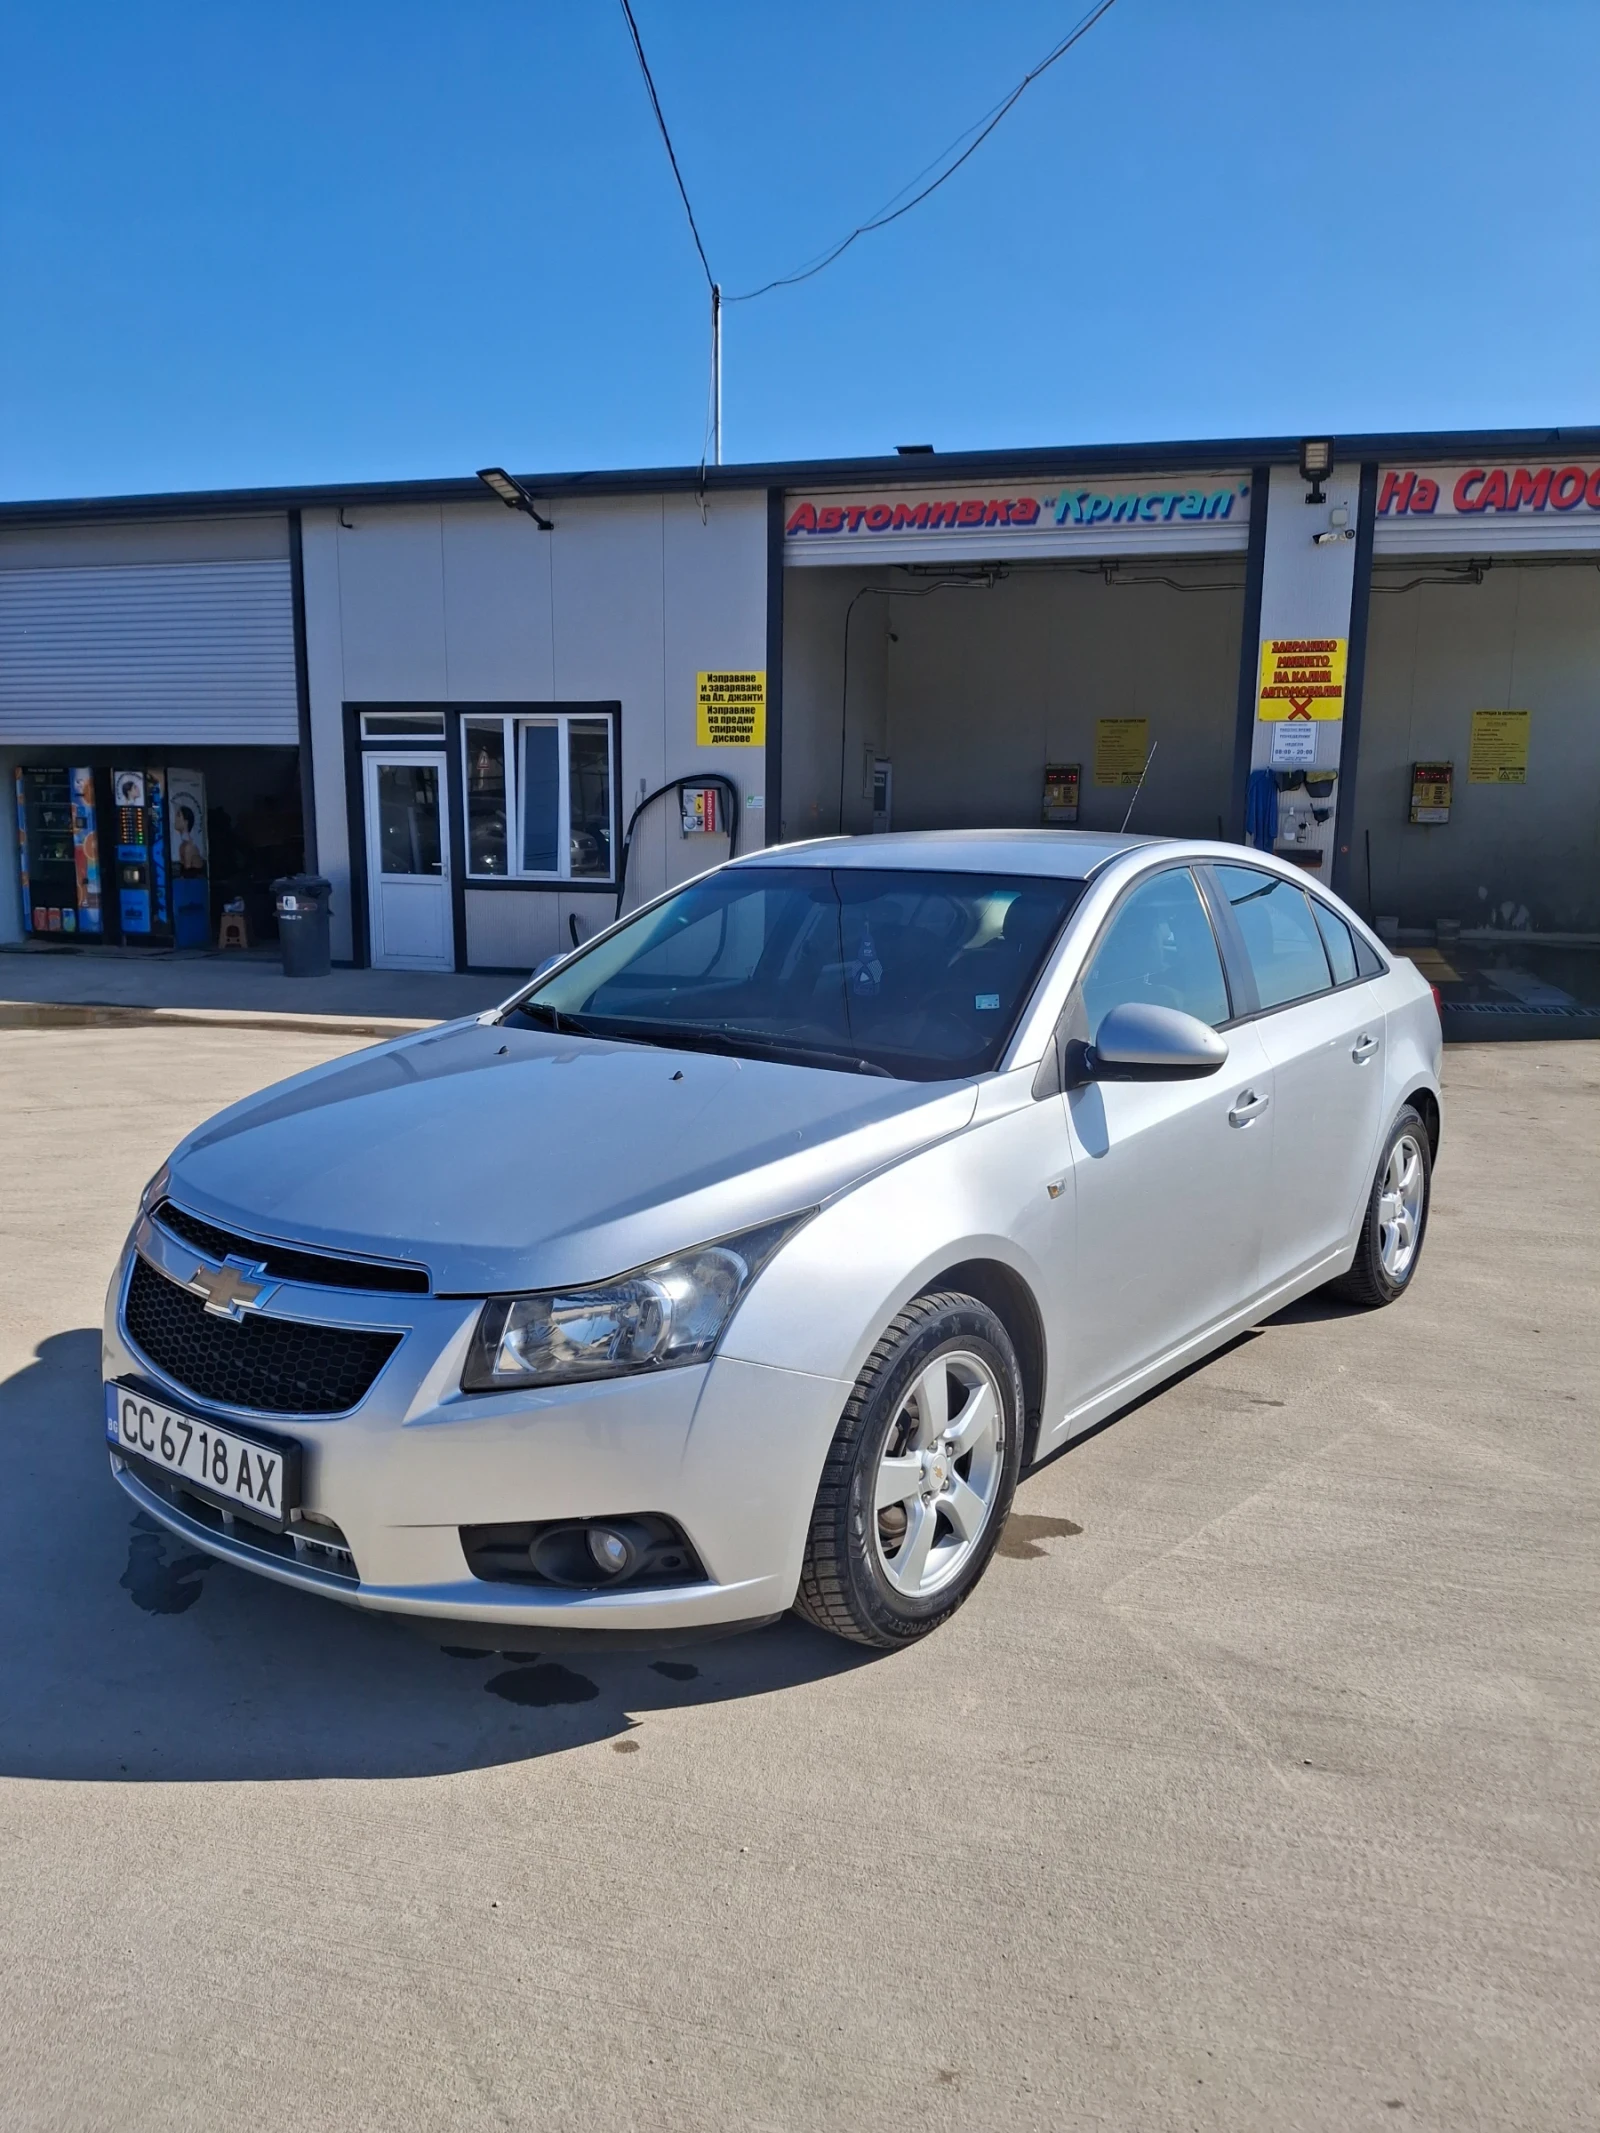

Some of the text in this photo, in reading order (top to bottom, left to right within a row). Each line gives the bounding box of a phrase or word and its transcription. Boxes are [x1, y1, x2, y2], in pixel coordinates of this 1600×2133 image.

[1377, 471, 1439, 514] На
[786, 497, 1040, 535] Автомивка
[707, 673, 756, 683] Изправяне
[1273, 671, 1289, 683] НА
[708, 684, 763, 692] заваряване
[700, 693, 763, 703] на Ал. джанти
[707, 705, 756, 715] Изправяне
[708, 716, 755, 724] на предни
[709, 725, 753, 734] спирачни
[712, 735, 751, 743] дискове
[107, 1417, 118, 1434] BG
